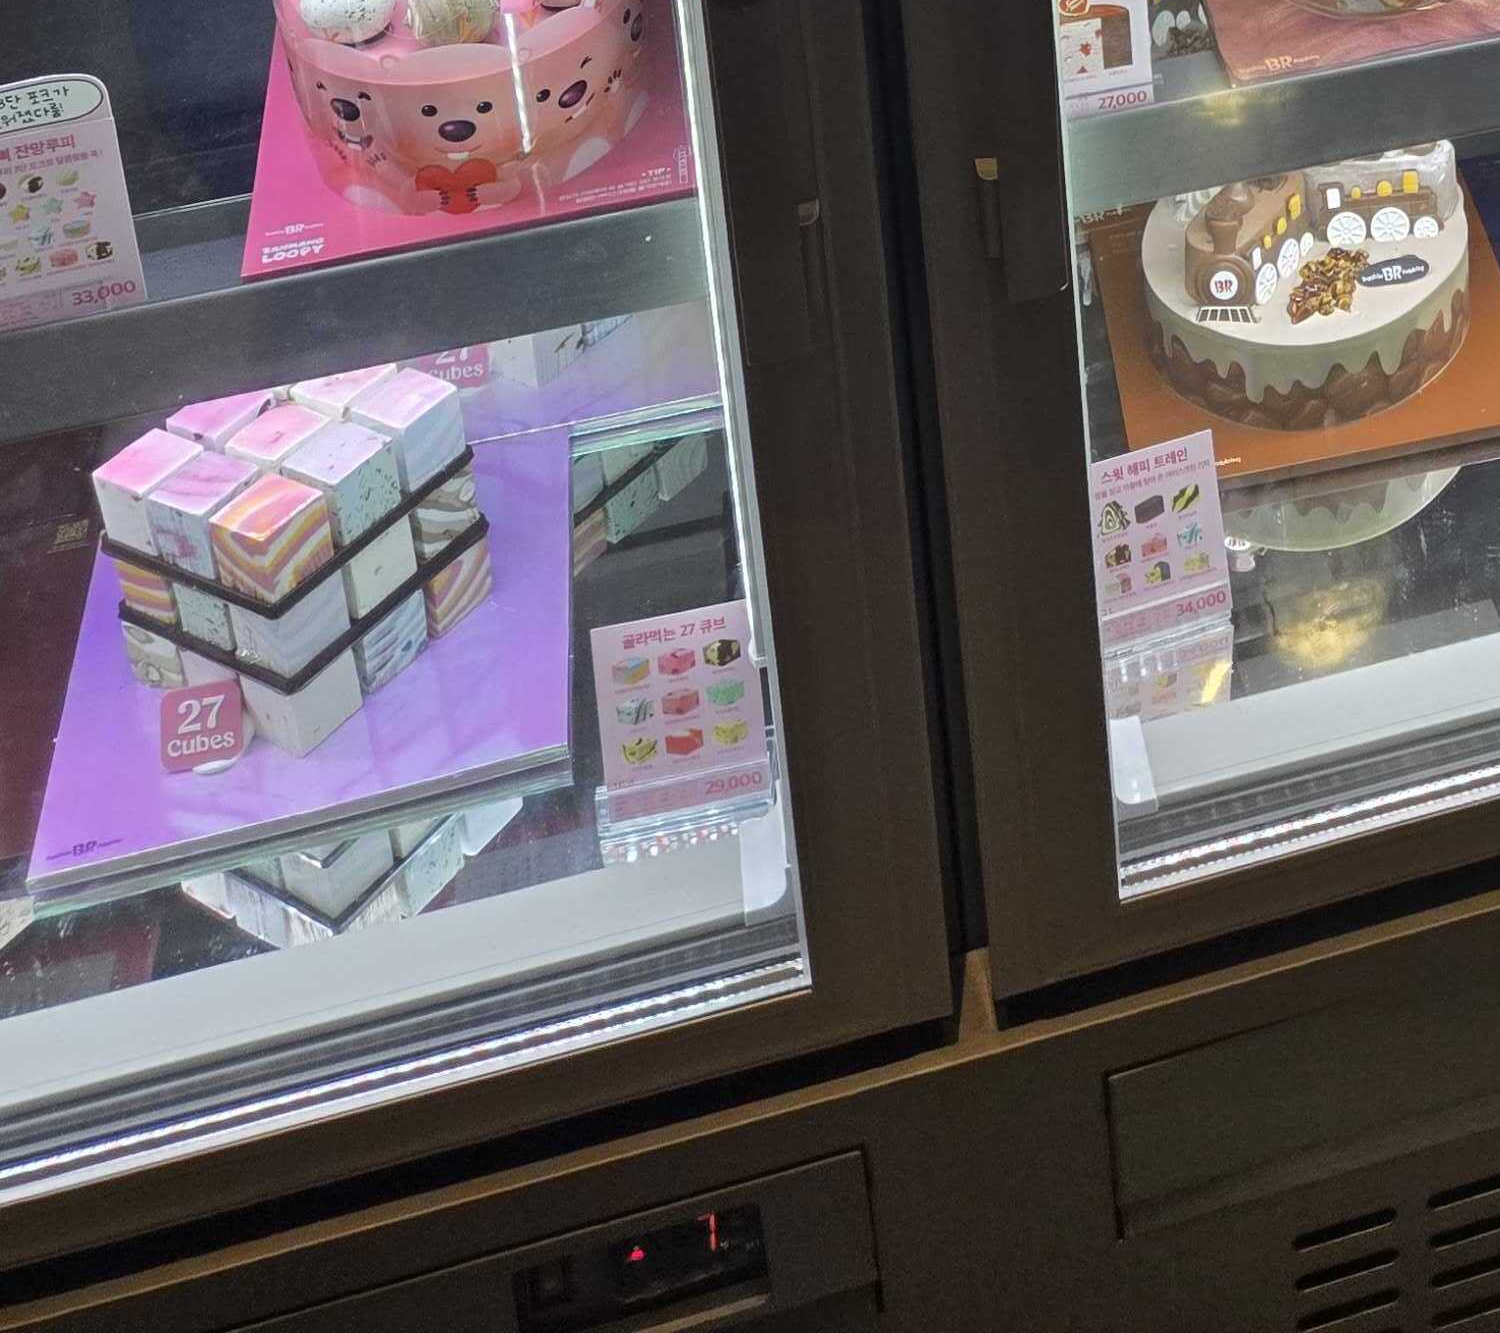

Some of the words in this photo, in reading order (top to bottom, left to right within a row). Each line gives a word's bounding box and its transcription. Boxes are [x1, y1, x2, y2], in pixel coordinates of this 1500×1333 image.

[1265, 55, 1293, 71] BR
[27, 86, 70, 105] 포크가
[1099, 90, 1148, 110] 27,000
[15, 134, 75, 159] 잔망루피
[262, 245, 325, 263] LOOPY
[1382, 265, 1402, 280] BR
[71, 281, 136, 306] 33,000
[1215, 278, 1233, 293] BR
[1100, 469, 1124, 483] 스윗
[1127, 461, 1150, 477] 해피
[1154, 448, 1188, 468] 트레인
[1176, 591, 1226, 617] 34,000
[622, 627, 676, 649] 골라먹는
[680, 623, 695, 636] 27
[699, 617, 726, 632] 큐브
[178, 694, 225, 734] 27
[167, 732, 235, 757] cubes
[705, 771, 762, 795] 29,000
[72, 841, 97, 856] BR
